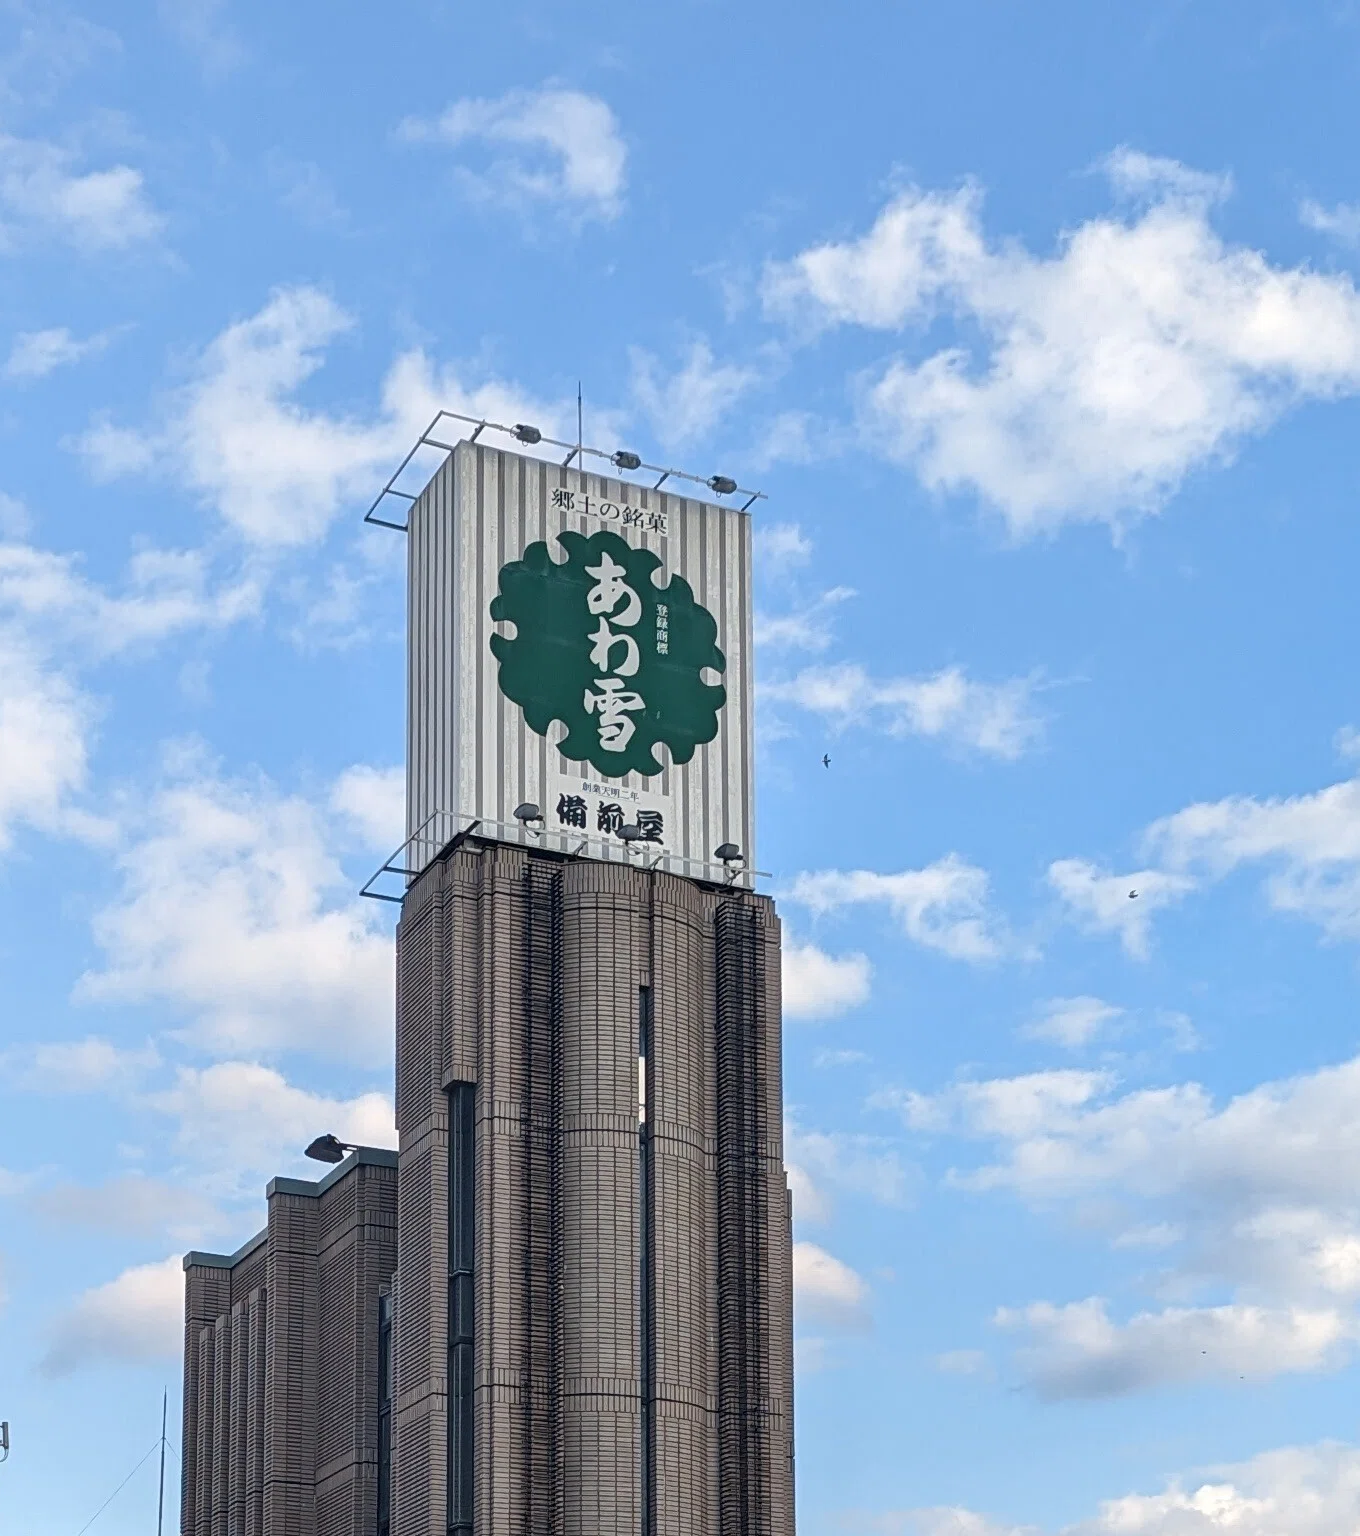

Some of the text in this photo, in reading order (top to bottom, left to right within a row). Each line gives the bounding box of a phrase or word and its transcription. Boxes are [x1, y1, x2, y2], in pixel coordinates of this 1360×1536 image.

[552, 489, 667, 534] 郷土の銘菓
[584, 552, 646, 752] あわ雪
[656, 604, 669, 655] 登録商標
[556, 793, 664, 845] 備前屋
